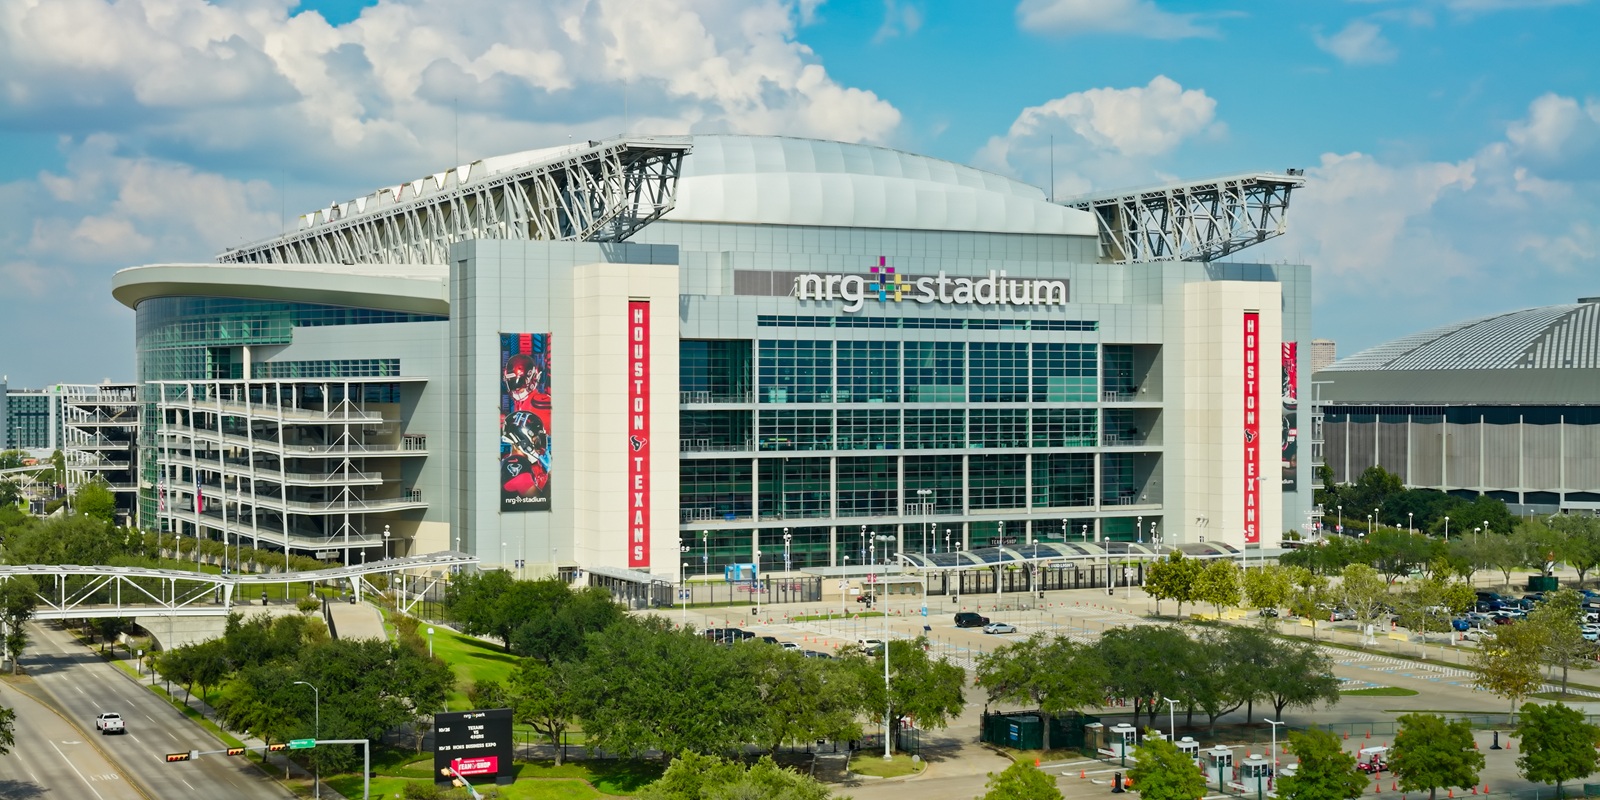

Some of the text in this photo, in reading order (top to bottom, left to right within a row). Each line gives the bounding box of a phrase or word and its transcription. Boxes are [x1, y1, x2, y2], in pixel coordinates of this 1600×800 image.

[798, 270, 1066, 313] nrg stadium
[634, 308, 643, 561] HOUSTON TEXANS
